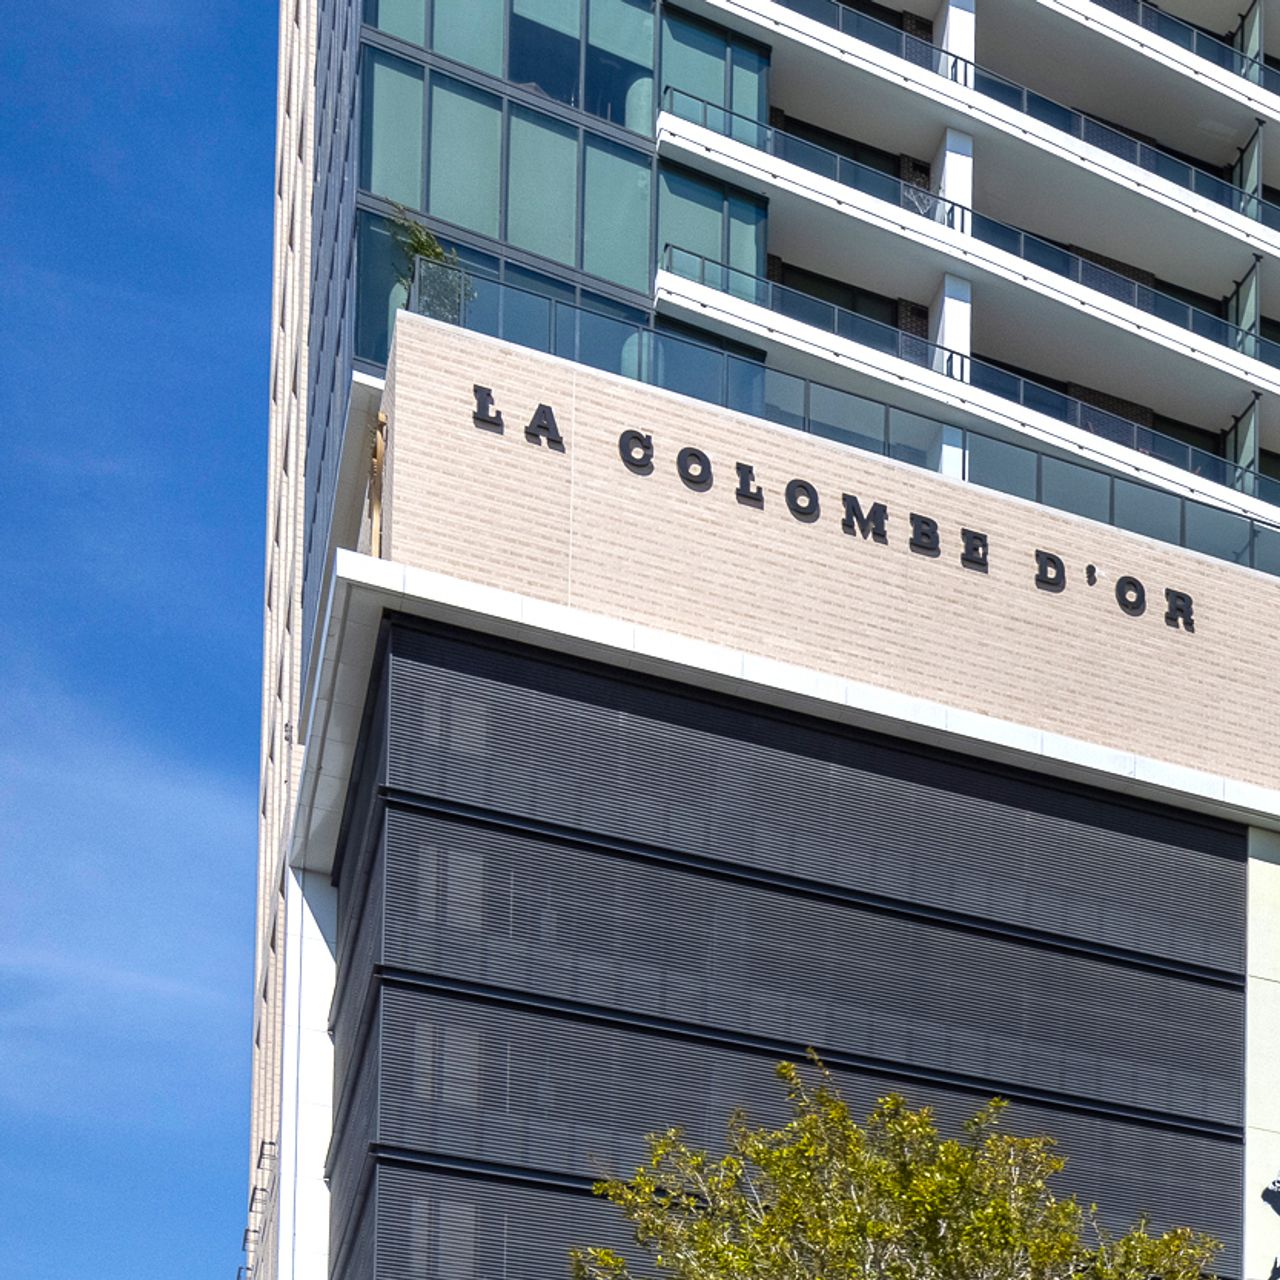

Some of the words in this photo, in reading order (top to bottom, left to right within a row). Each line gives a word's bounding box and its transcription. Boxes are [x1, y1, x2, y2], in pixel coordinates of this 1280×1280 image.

[472, 384, 565, 454] LA
[619, 430, 989, 574] COLOMBE
[1035, 549, 1195, 633] D'OR
